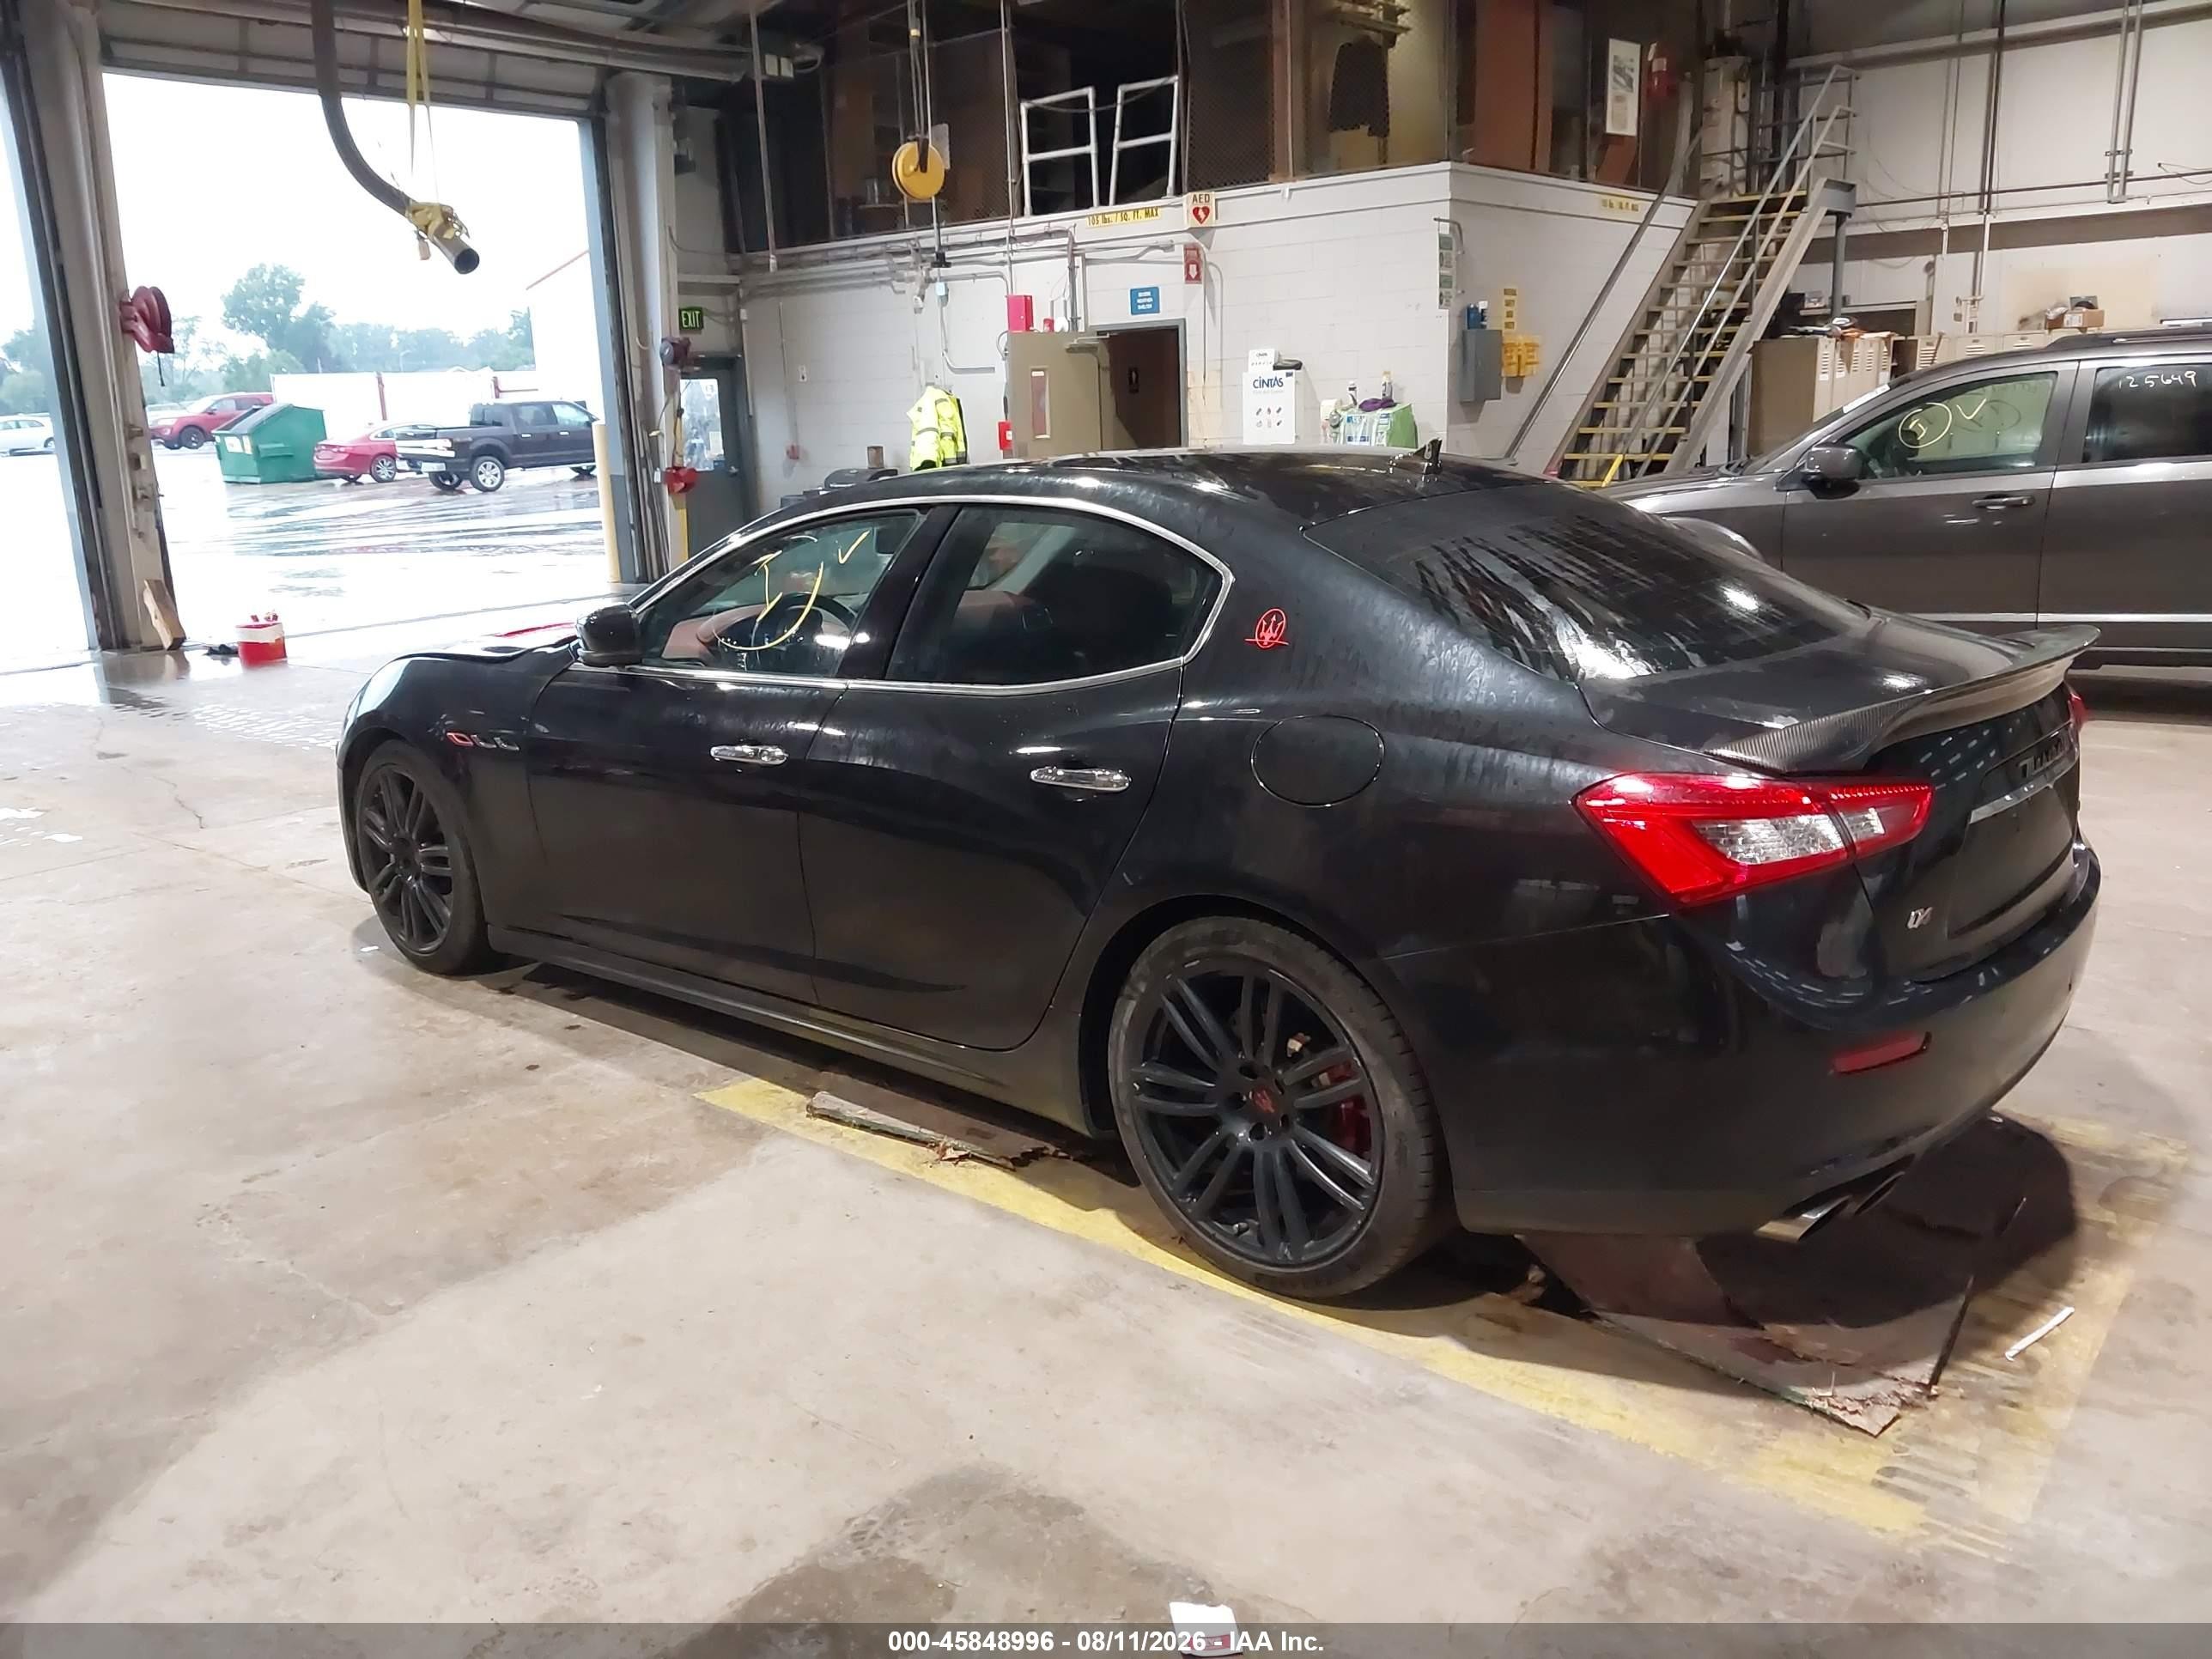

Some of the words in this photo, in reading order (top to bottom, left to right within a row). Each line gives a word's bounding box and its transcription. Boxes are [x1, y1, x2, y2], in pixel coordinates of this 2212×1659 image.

[1192, 193, 1211, 204] AED
[1120, 211, 1131, 222] SQ.
[1145, 206, 1159, 218] MAX
[681, 310, 702, 328] EXIT
